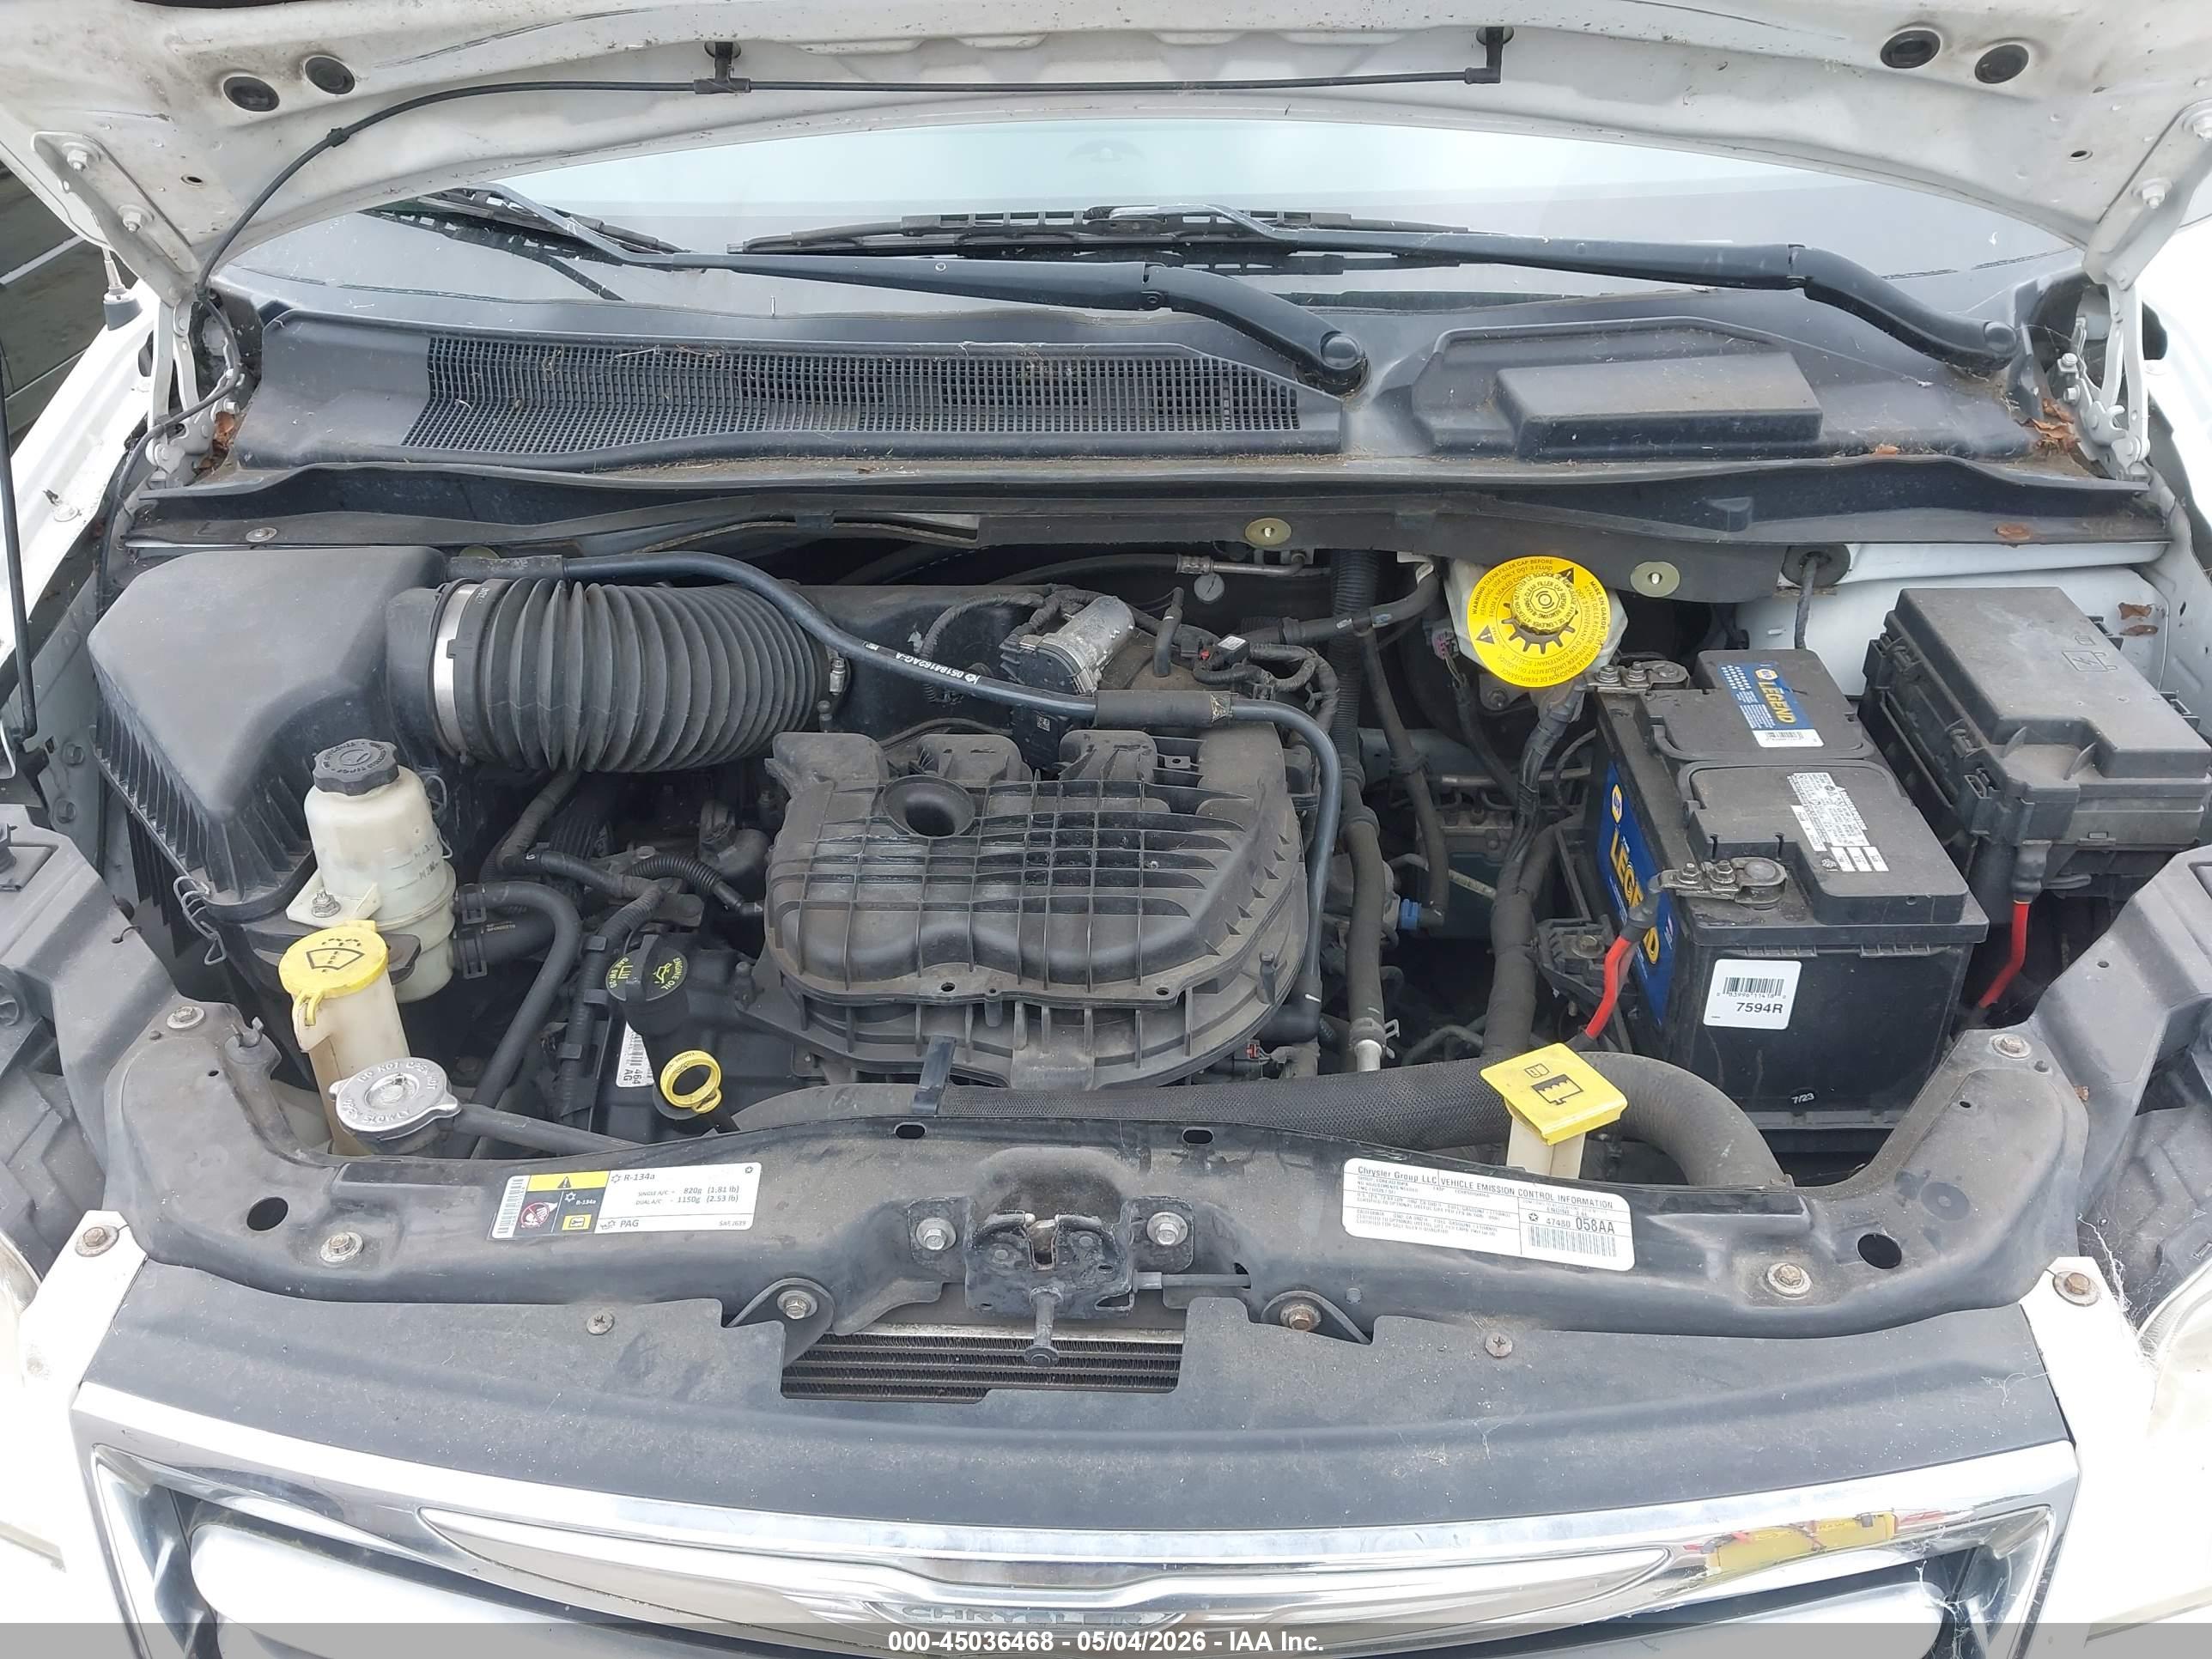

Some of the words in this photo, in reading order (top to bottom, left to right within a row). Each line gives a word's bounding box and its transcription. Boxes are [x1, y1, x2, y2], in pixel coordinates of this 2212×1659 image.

[1758, 681, 1797, 723] LEGEND
[1610, 830, 1660, 964] LEGED
[672, 957, 683, 980] ENGINE
[660, 980, 676, 990] OIL
[1735, 1002, 1784, 1014] 7594R
[623, 1068, 633, 1081] AG
[632, 1068, 641, 1085] 464
[1790, 1092, 1814, 1104] 7/23
[623, 1173, 655, 1182] R-134a
[1358, 1166, 1391, 1177] Chrysler
[1394, 1171, 1419, 1183] Group
[1422, 1175, 1437, 1184] LLC
[684, 1187, 702, 1195] 820g
[708, 1185, 727, 1194] (1.81
[729, 1185, 739, 1194] lb)
[1441, 1177, 1474, 1189] VEHICLE
[1477, 1182, 1516, 1195] EMISSION
[1517, 1188, 1555, 1200] CONTROL
[1557, 1194, 1613, 1209] INFORMATION
[678, 1195, 701, 1204] 1150g
[706, 1194, 726, 1203] (2.53
[727, 1194, 738, 1203] lb)
[619, 1219, 640, 1228] PAG
[1576, 1217, 1615, 1234] 058AA
